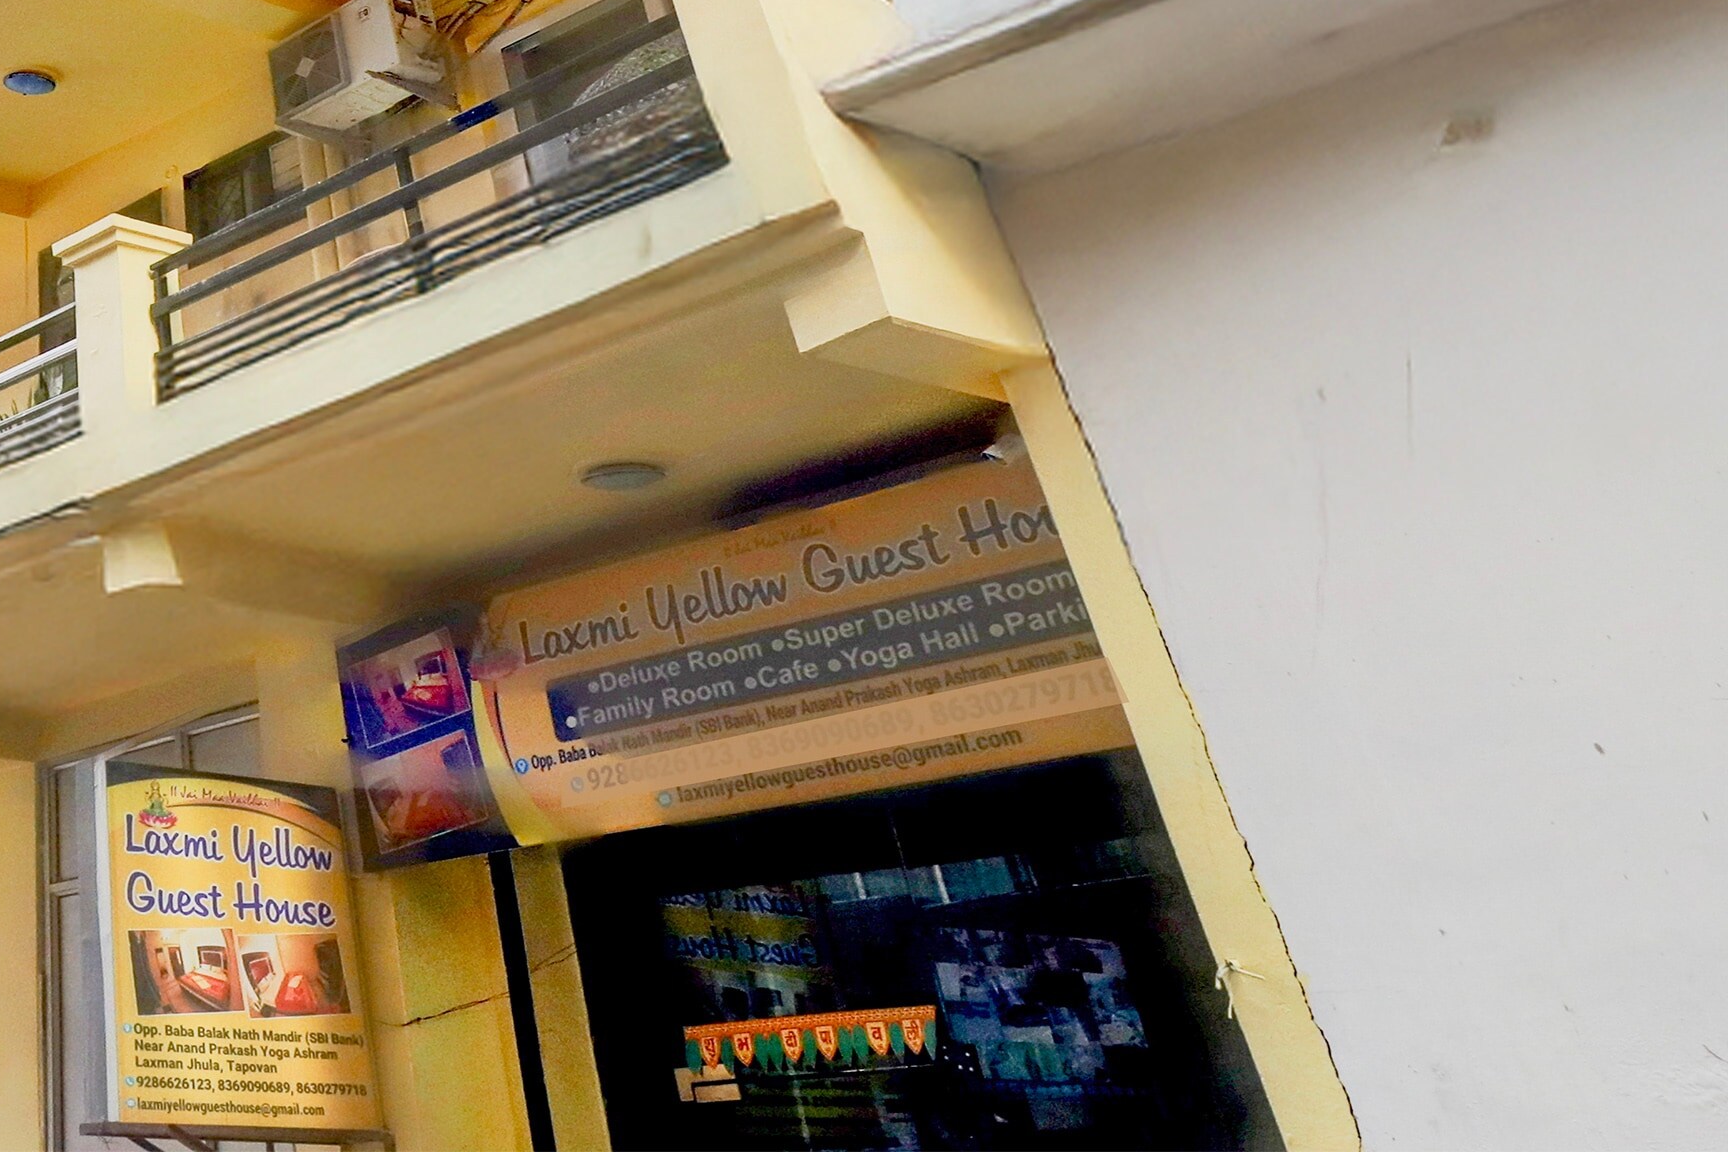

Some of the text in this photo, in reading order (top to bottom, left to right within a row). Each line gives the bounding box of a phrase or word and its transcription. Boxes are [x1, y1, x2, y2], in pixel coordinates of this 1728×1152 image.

[518, 602, 639, 665] Laxmi
[645, 566, 787, 645] Yellow
[802, 523, 951, 593] Guest
[599, 659, 681, 693] Deluxe
[687, 641, 763, 672] Room
[783, 616, 866, 649] Super
[872, 594, 973, 631] Deluxe
[576, 697, 655, 728] Family
[661, 678, 737, 710] Room
[756, 660, 820, 689] Cafe
[839, 640, 915, 669] Yoga
[919, 621, 980, 654] Hall
[531, 754, 557, 773] Opp.
[558, 746, 587, 764] Baba
[766, 702, 797, 723] Near
[801, 691, 844, 716] Anand
[846, 682, 902, 709] Prakash
[903, 673, 941, 696] Yoga
[1006, 649, 1067, 674] Laxman
[676, 728, 1023, 803] laxmiyellowguesthouse@gmail.com
[126, 813, 332, 878] Laxmi Yellow
[127, 871, 336, 928] Guest House
[133, 1023, 363, 1047] Opp. Baba Balak Nath Mandir (SBI Bank)
[134, 1039, 338, 1060] Near Anand Prakash Yoga Ashram
[135, 1055, 278, 1075] Laxman Jhula, Tapovan
[136, 1075, 215, 1093] 9286626123,
[296, 1082, 367, 1097] 8630279718
[137, 1097, 325, 1118] laxmiyellowguesthouse@gmail.com
